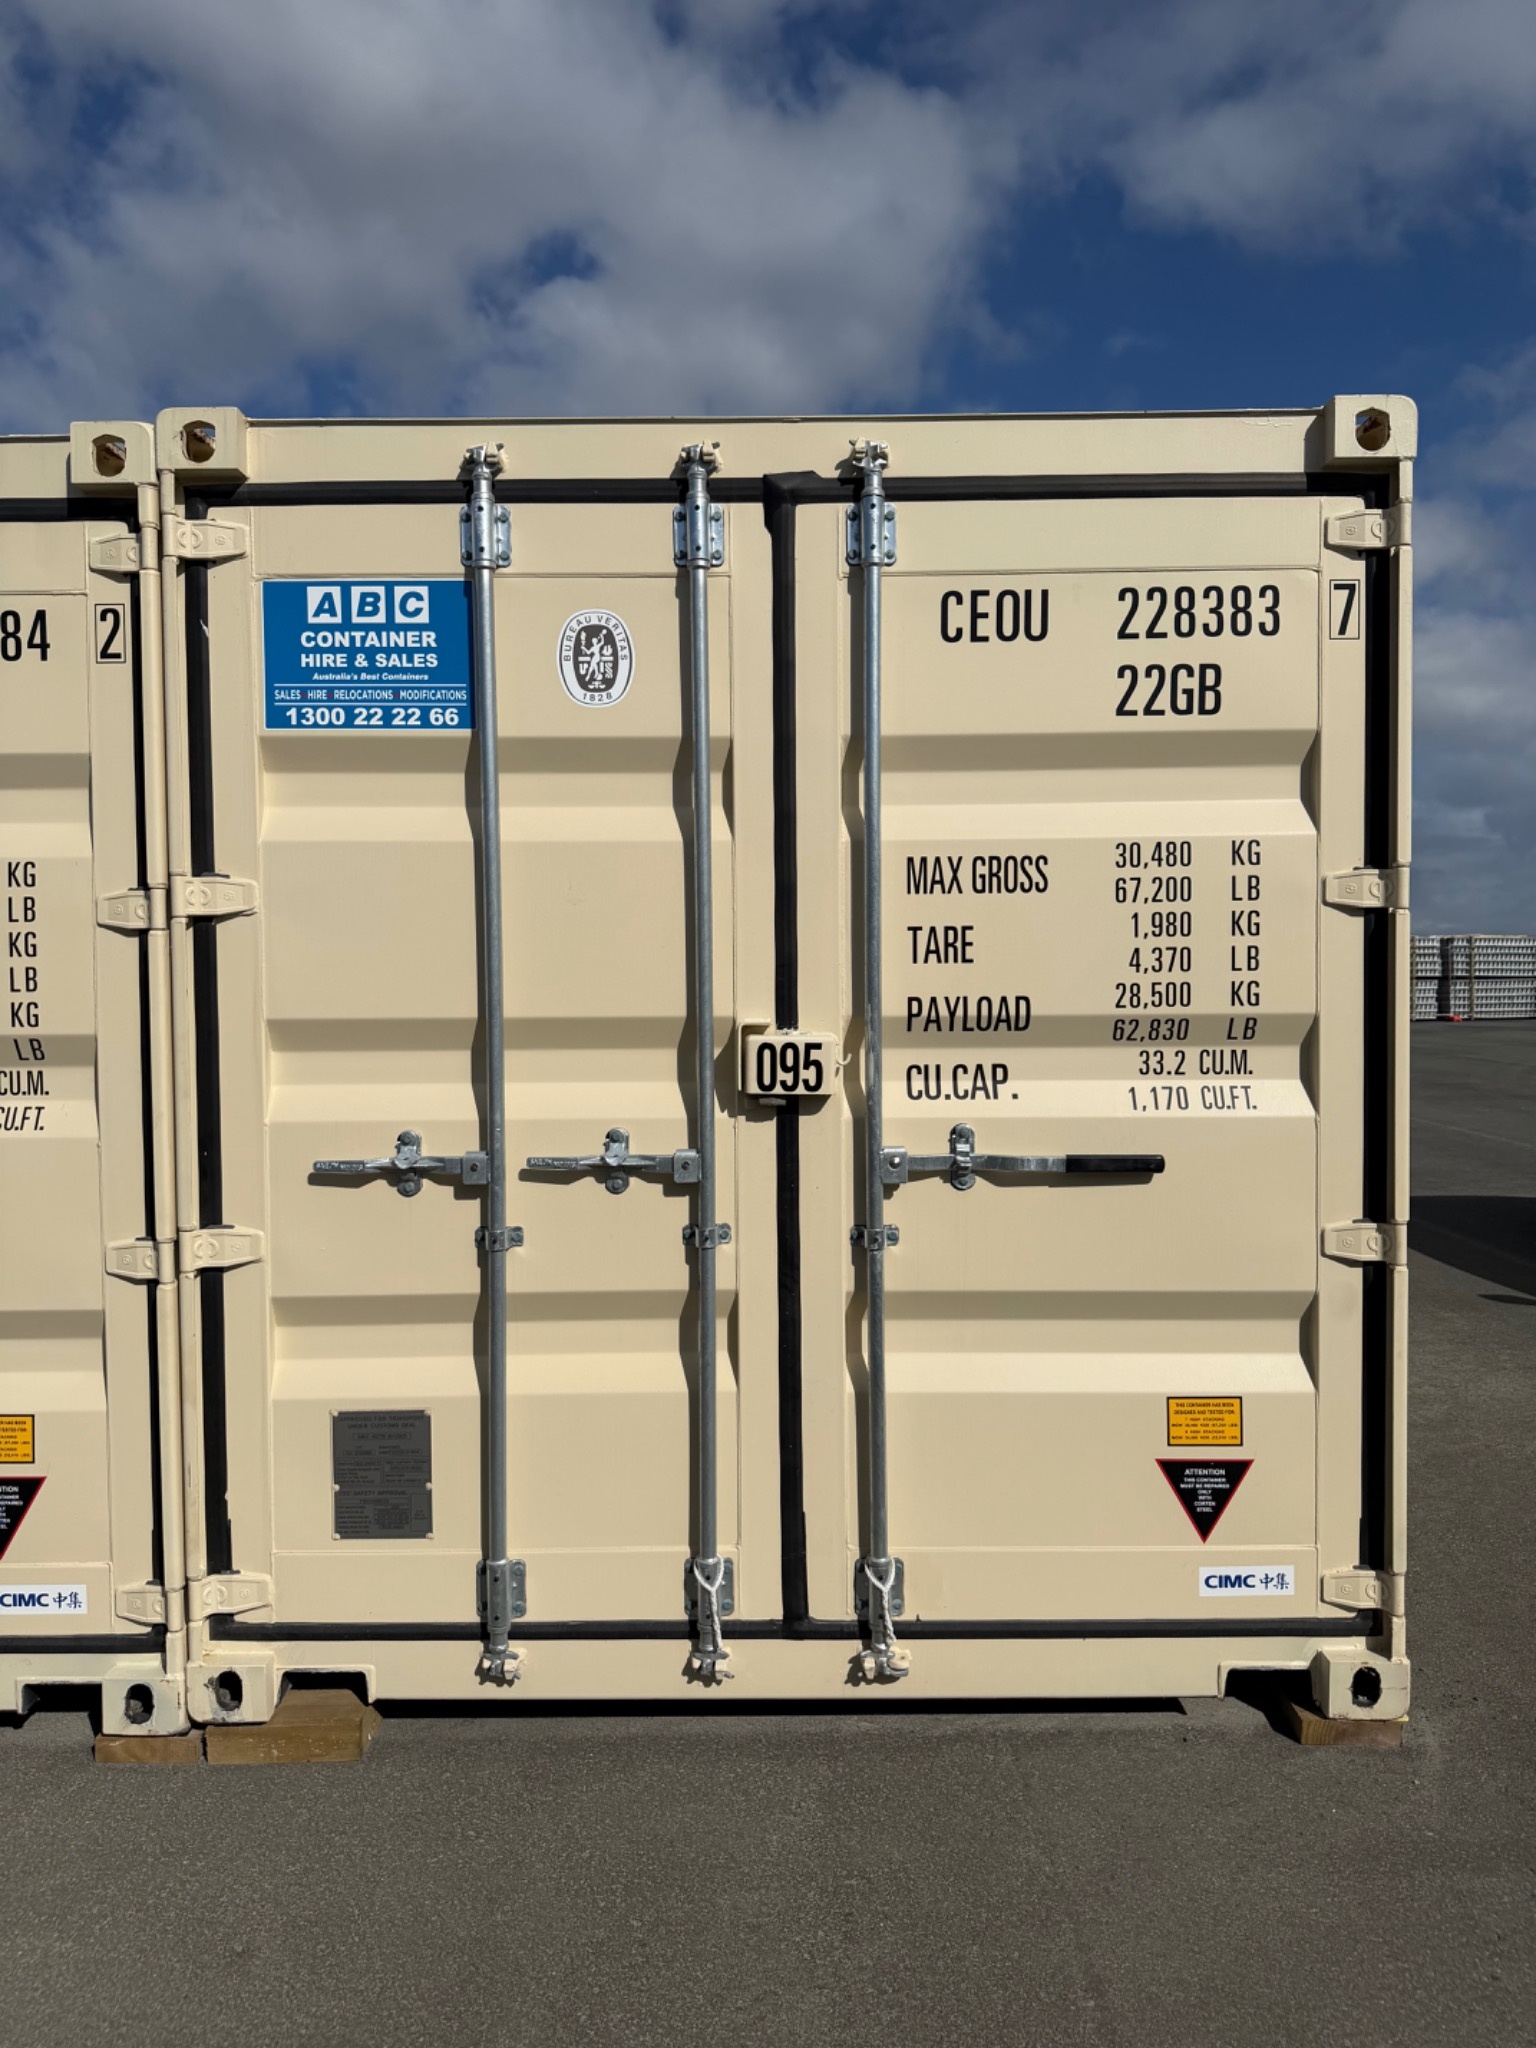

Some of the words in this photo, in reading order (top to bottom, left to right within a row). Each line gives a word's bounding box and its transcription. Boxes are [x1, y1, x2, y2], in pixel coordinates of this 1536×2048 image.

[310, 590, 426, 619] ABC
[941, 589, 1048, 642] CEOU
[1118, 585, 1279, 639] 228383
[1333, 583, 1357, 636] 7
[99, 608, 122, 659] 2
[301, 632, 436, 647] CONTAINER
[563, 616, 592, 662] BUREAU
[597, 615, 628, 661] VERITAS
[302, 654, 347, 667] HIRE
[355, 654, 368, 667] &
[376, 654, 437, 667] SALES
[312, 672, 358, 680] Australia's
[360, 672, 380, 680] Best
[382, 672, 429, 680] Containers
[274, 690, 300, 700] SALES
[307, 690, 328, 700] HIRE
[334, 690, 393, 700] RELOCATIONS
[400, 690, 467, 700] MODIFICATIONS
[1116, 664, 1221, 716] 22GB
[287, 708, 345, 725] 1300
[355, 708, 382, 724] 22
[392, 708, 420, 725] 22
[430, 708, 458, 725] 66
[1116, 841, 1191, 868] 30,480
[1232, 840, 1260, 865] KG
[8, 862, 35, 887] KG
[907, 856, 962, 894] MAX
[972, 855, 1048, 893] GROSS
[1116, 877, 1191, 903] 67,200
[1232, 875, 1260, 901] LB
[8, 897, 35, 922] LB
[1132, 912, 1191, 939] 1,980
[1232, 910, 1259, 936] KG
[9, 932, 36, 957] KG
[908, 926, 973, 963] TARE
[1129, 947, 1191, 973] 4,370
[1232, 946, 1259, 971] LB
[10, 967, 37, 992] LB
[1116, 982, 1191, 1008] 28,500
[1231, 981, 1259, 1006] KG
[11, 1002, 38, 1027] KG
[907, 996, 1030, 1031] PAYLOAD
[1113, 1019, 1189, 1042] 62,830
[1227, 1018, 1257, 1039] LB
[14, 1039, 45, 1060] LB
[1139, 1050, 1185, 1075] 33.2
[1200, 1049, 1252, 1075] CU.M.
[756, 1042, 823, 1092] 095
[907, 1064, 1017, 1100] CU.CAP.
[1129, 1086, 1188, 1111] 1,170
[1201, 1086, 1257, 1109] CU.FT.
[1204, 1575, 1256, 1588] CIMC
[1260, 1573, 1290, 1590] 中集
[0, 1593, 49, 1607] CIMC
[52, 1592, 82, 1608] 中集
